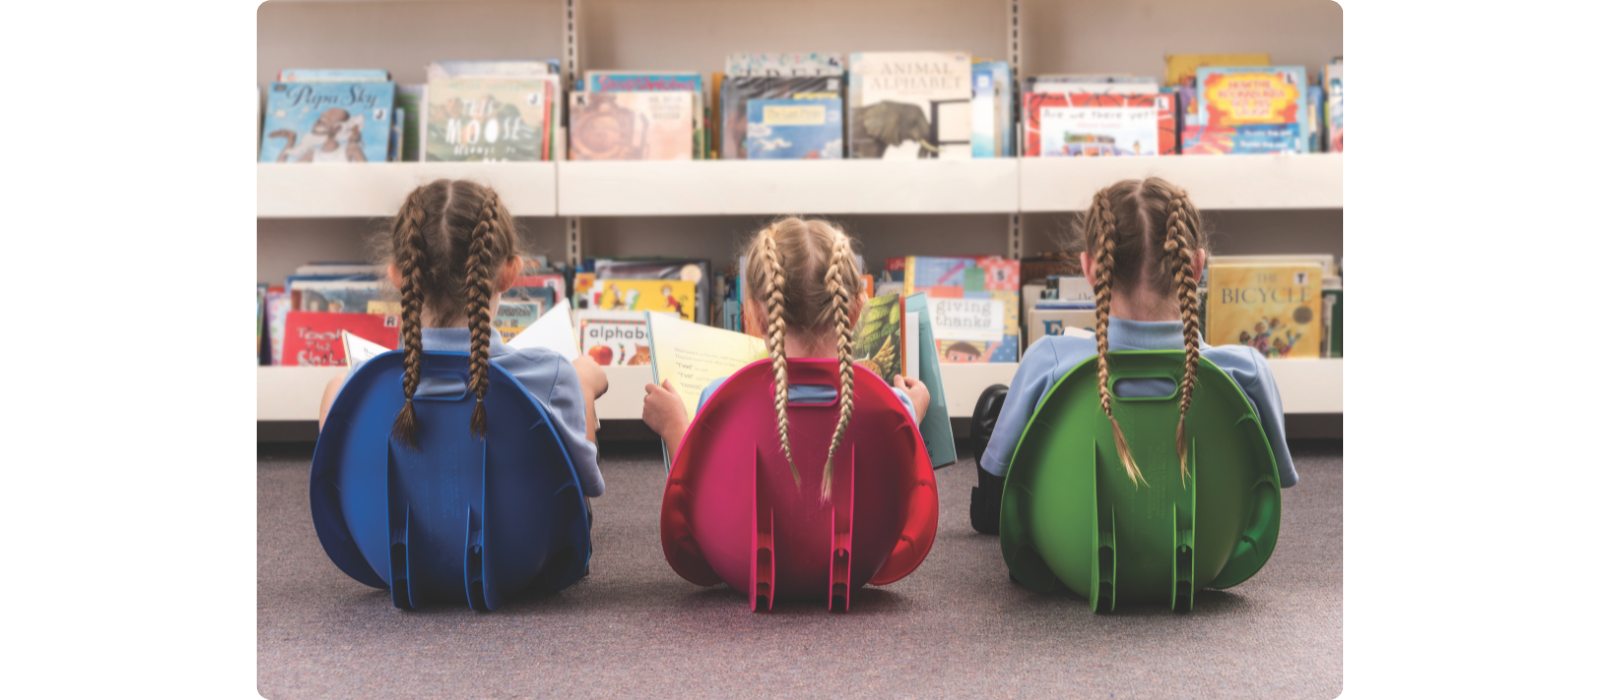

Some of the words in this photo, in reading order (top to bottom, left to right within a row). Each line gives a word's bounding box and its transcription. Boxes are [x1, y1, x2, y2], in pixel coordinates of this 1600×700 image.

[880, 62, 953, 75] ANIMAL
[870, 76, 962, 89] ALPHABET
[286, 84, 340, 110] Papa
[341, 83, 378, 109] Sky
[1043, 109, 1064, 119] Are
[1069, 111, 1085, 119] we
[1091, 110, 1123, 119] there
[1129, 110, 1155, 121] yet?
[445, 117, 521, 144] MOOSE
[1256, 272, 1278, 283] THE
[1221, 287, 1312, 304] BICYCLE
[936, 300, 991, 317] giving
[386, 316, 395, 326] R
[935, 315, 991, 328] thanks
